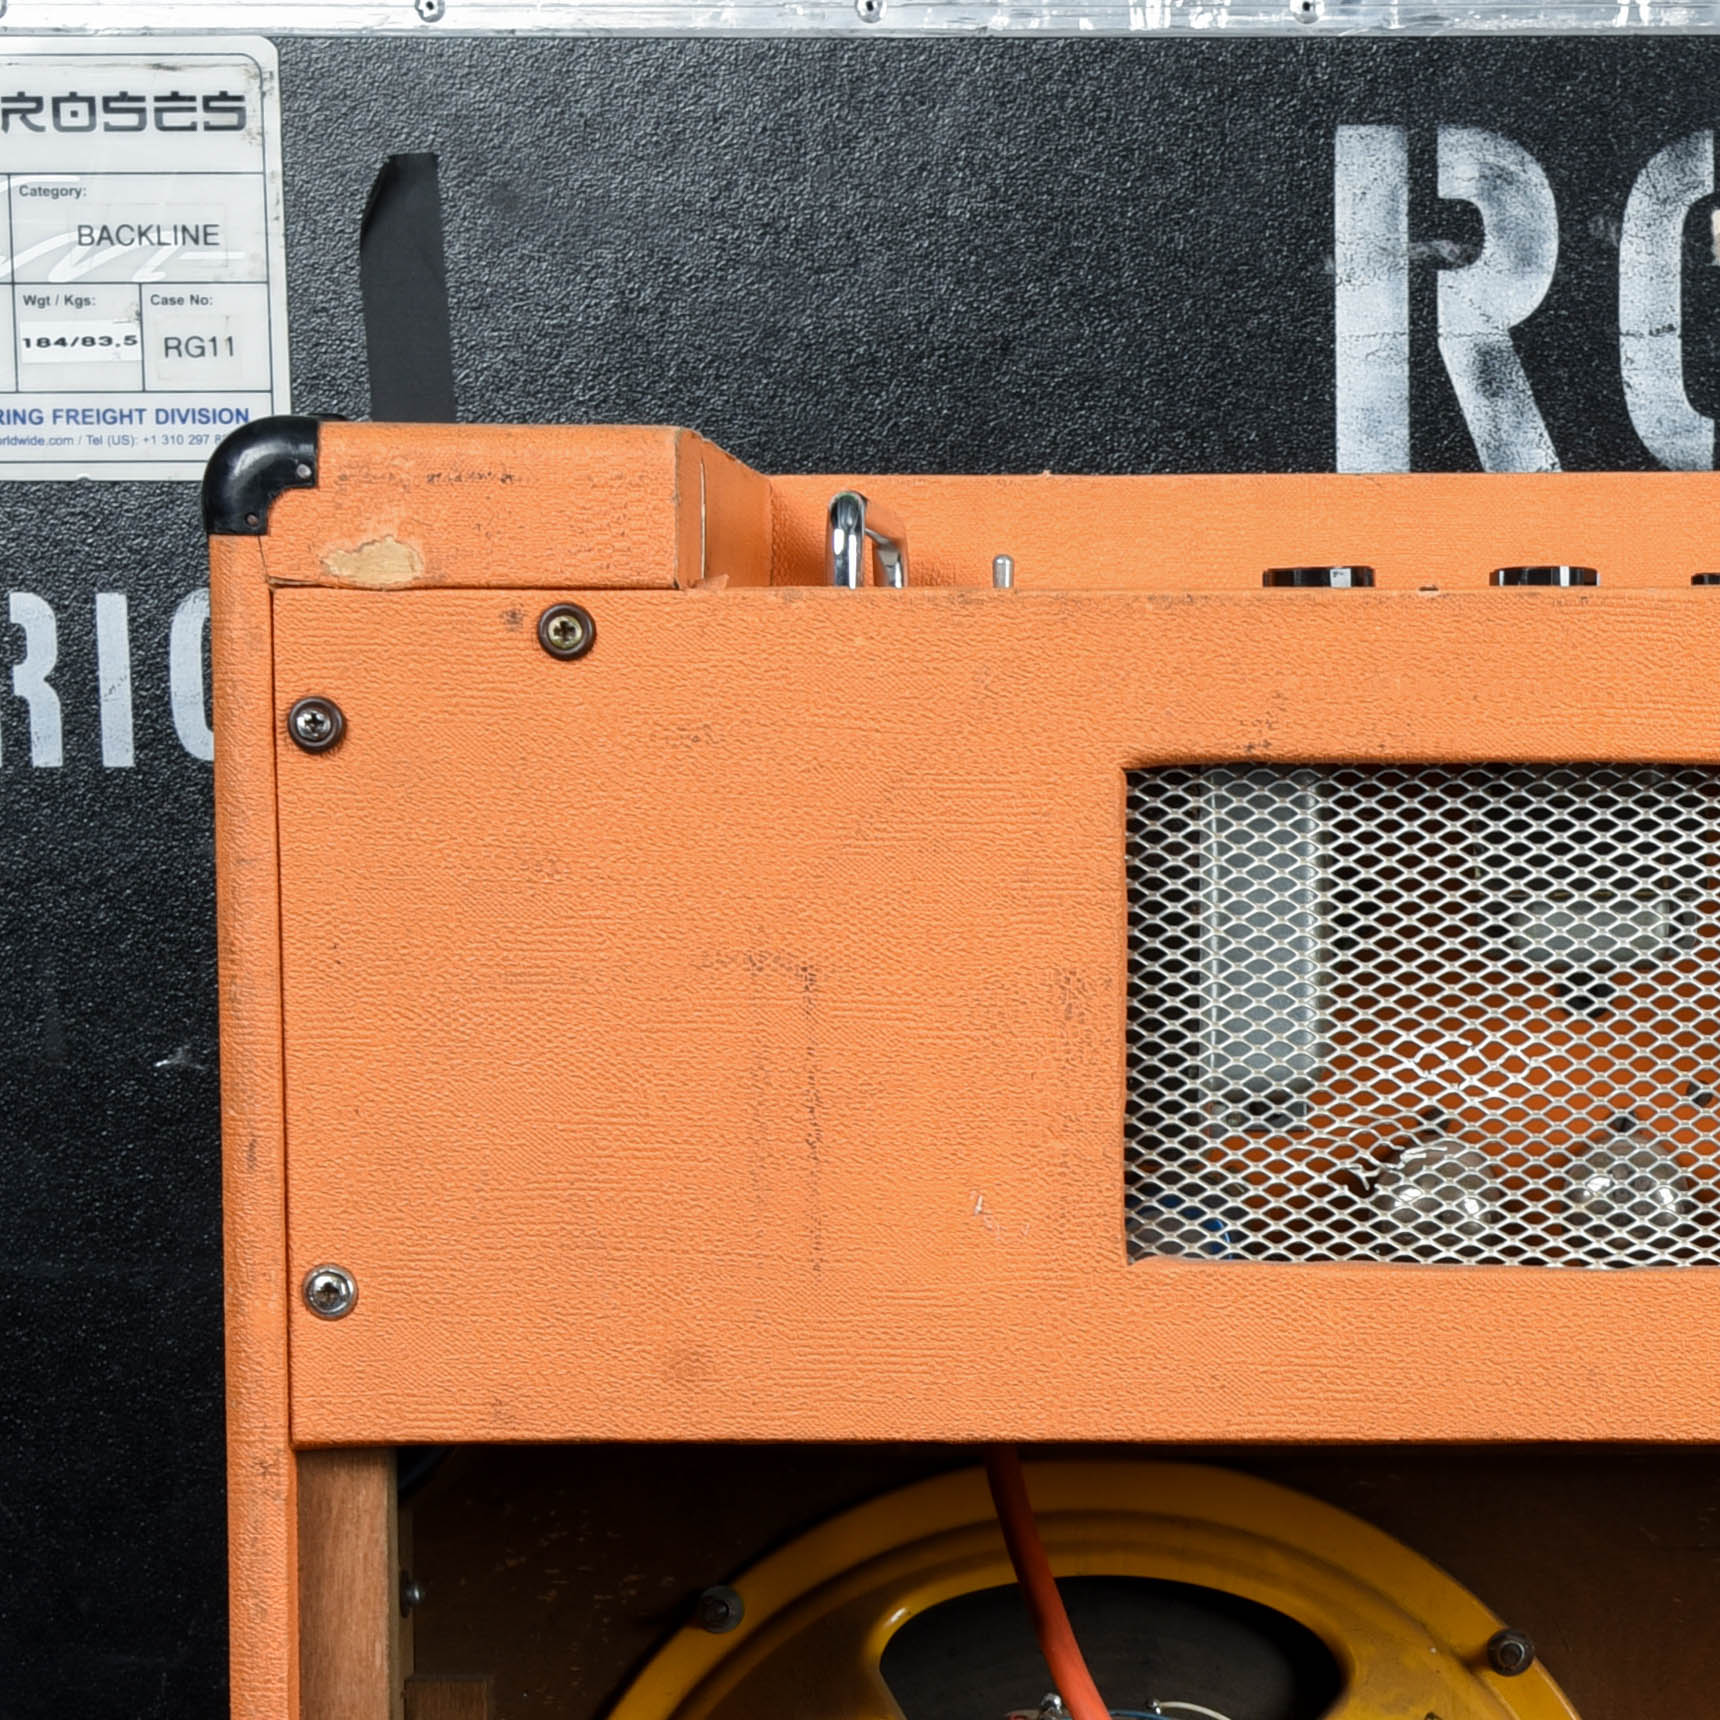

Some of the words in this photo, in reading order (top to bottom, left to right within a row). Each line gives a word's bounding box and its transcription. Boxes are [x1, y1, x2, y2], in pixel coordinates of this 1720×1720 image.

[1, 91, 246, 132] ROSES
[19, 185, 87, 199] Category:
[77, 224, 220, 246] BACKLINE
[23, 295, 51, 309] Wgt
[64, 295, 96, 309] Kgs:
[150, 294, 185, 306] Case
[190, 294, 213, 306] No:
[164, 336, 234, 358] RG11
[52, 409, 147, 425] FREIGHT
[155, 408, 249, 425] DIVISION
[88, 435, 103, 446] Tel
[162, 435, 184, 446] 310
[189, 435, 209, 446] 297
